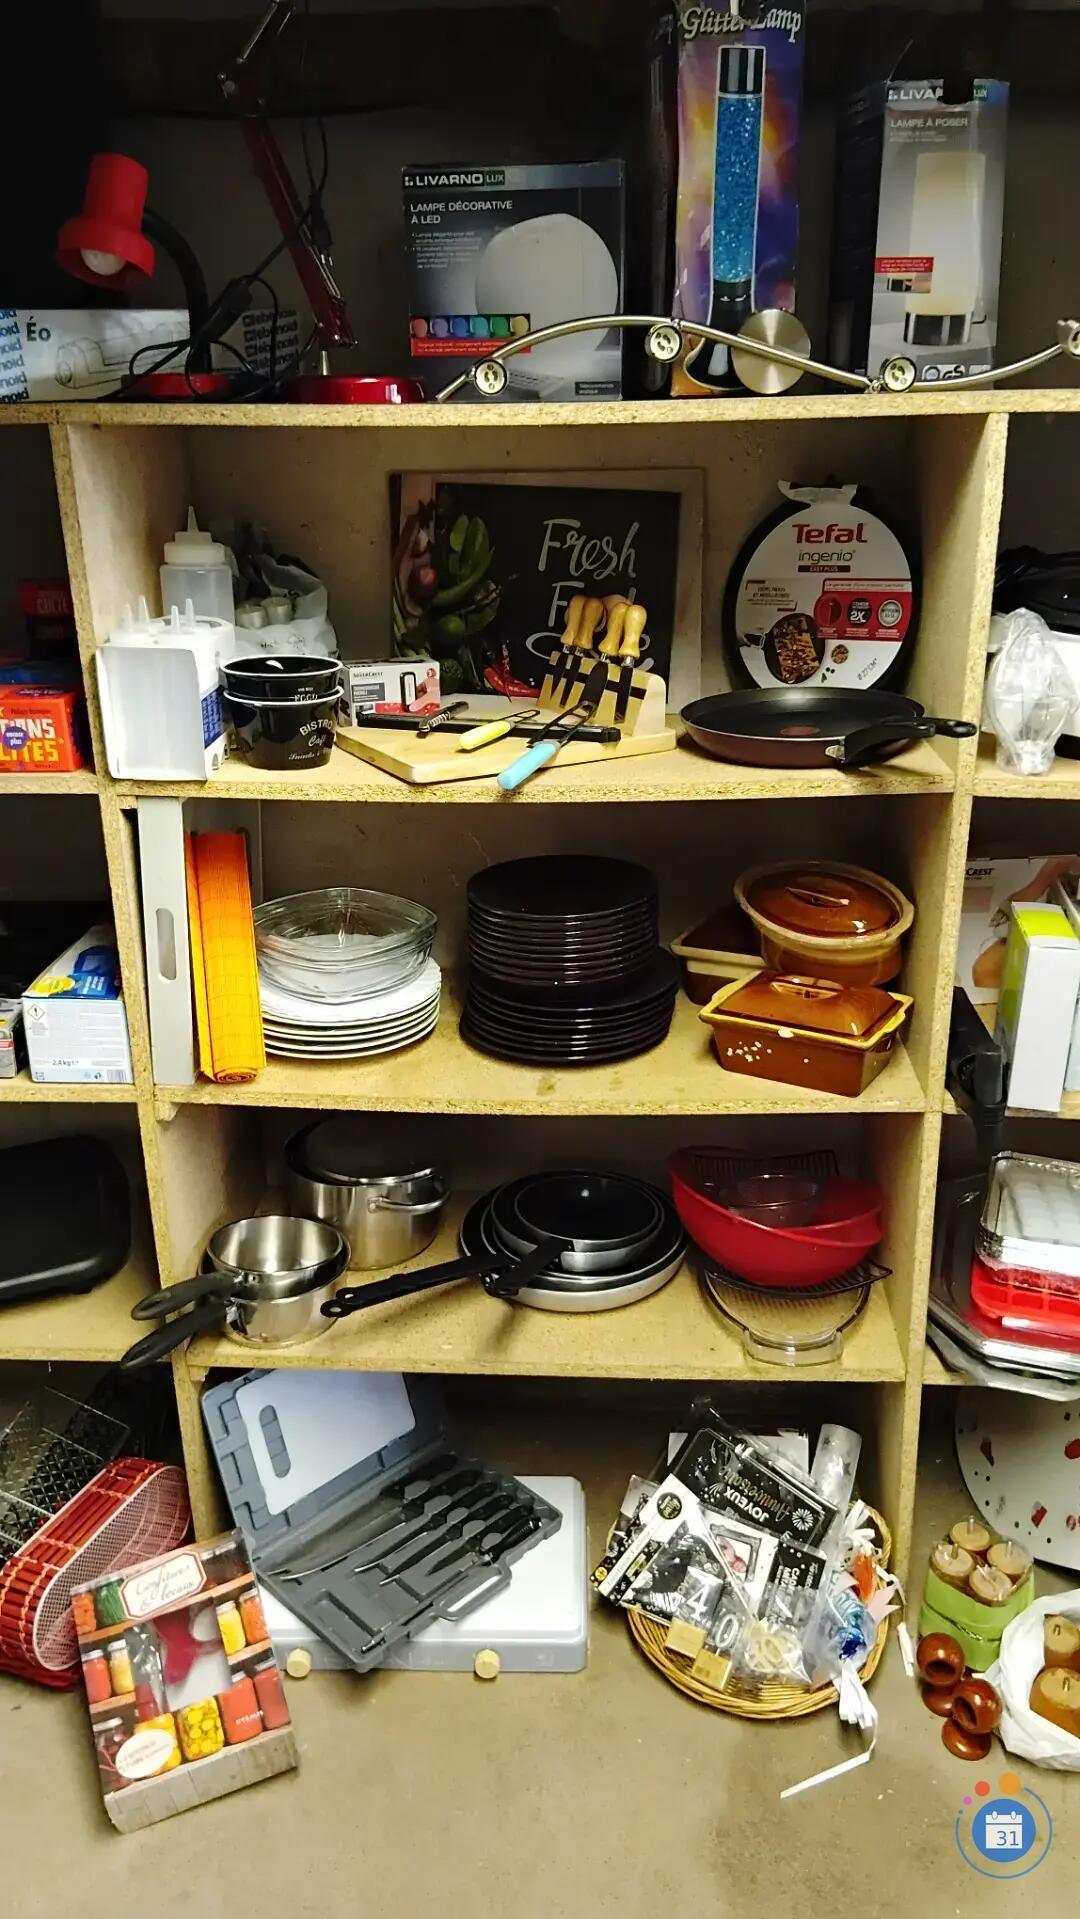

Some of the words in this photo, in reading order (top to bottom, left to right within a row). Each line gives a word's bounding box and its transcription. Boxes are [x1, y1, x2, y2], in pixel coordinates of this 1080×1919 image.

[415, 173, 483, 186] LIVARNO
[485, 174, 505, 183] LUX
[410, 203, 446, 213] LAMPE
[448, 200, 513, 211] DÉCORATIVE
[411, 214, 419, 225] À
[420, 215, 441, 224] LED
[26, 316, 51, 342] Éo
[792, 522, 868, 544] Tefal
[538, 518, 640, 580] Fresh
[299, 719, 334, 736] BISTRO
[723, 1485, 770, 1523] JOYEUX
